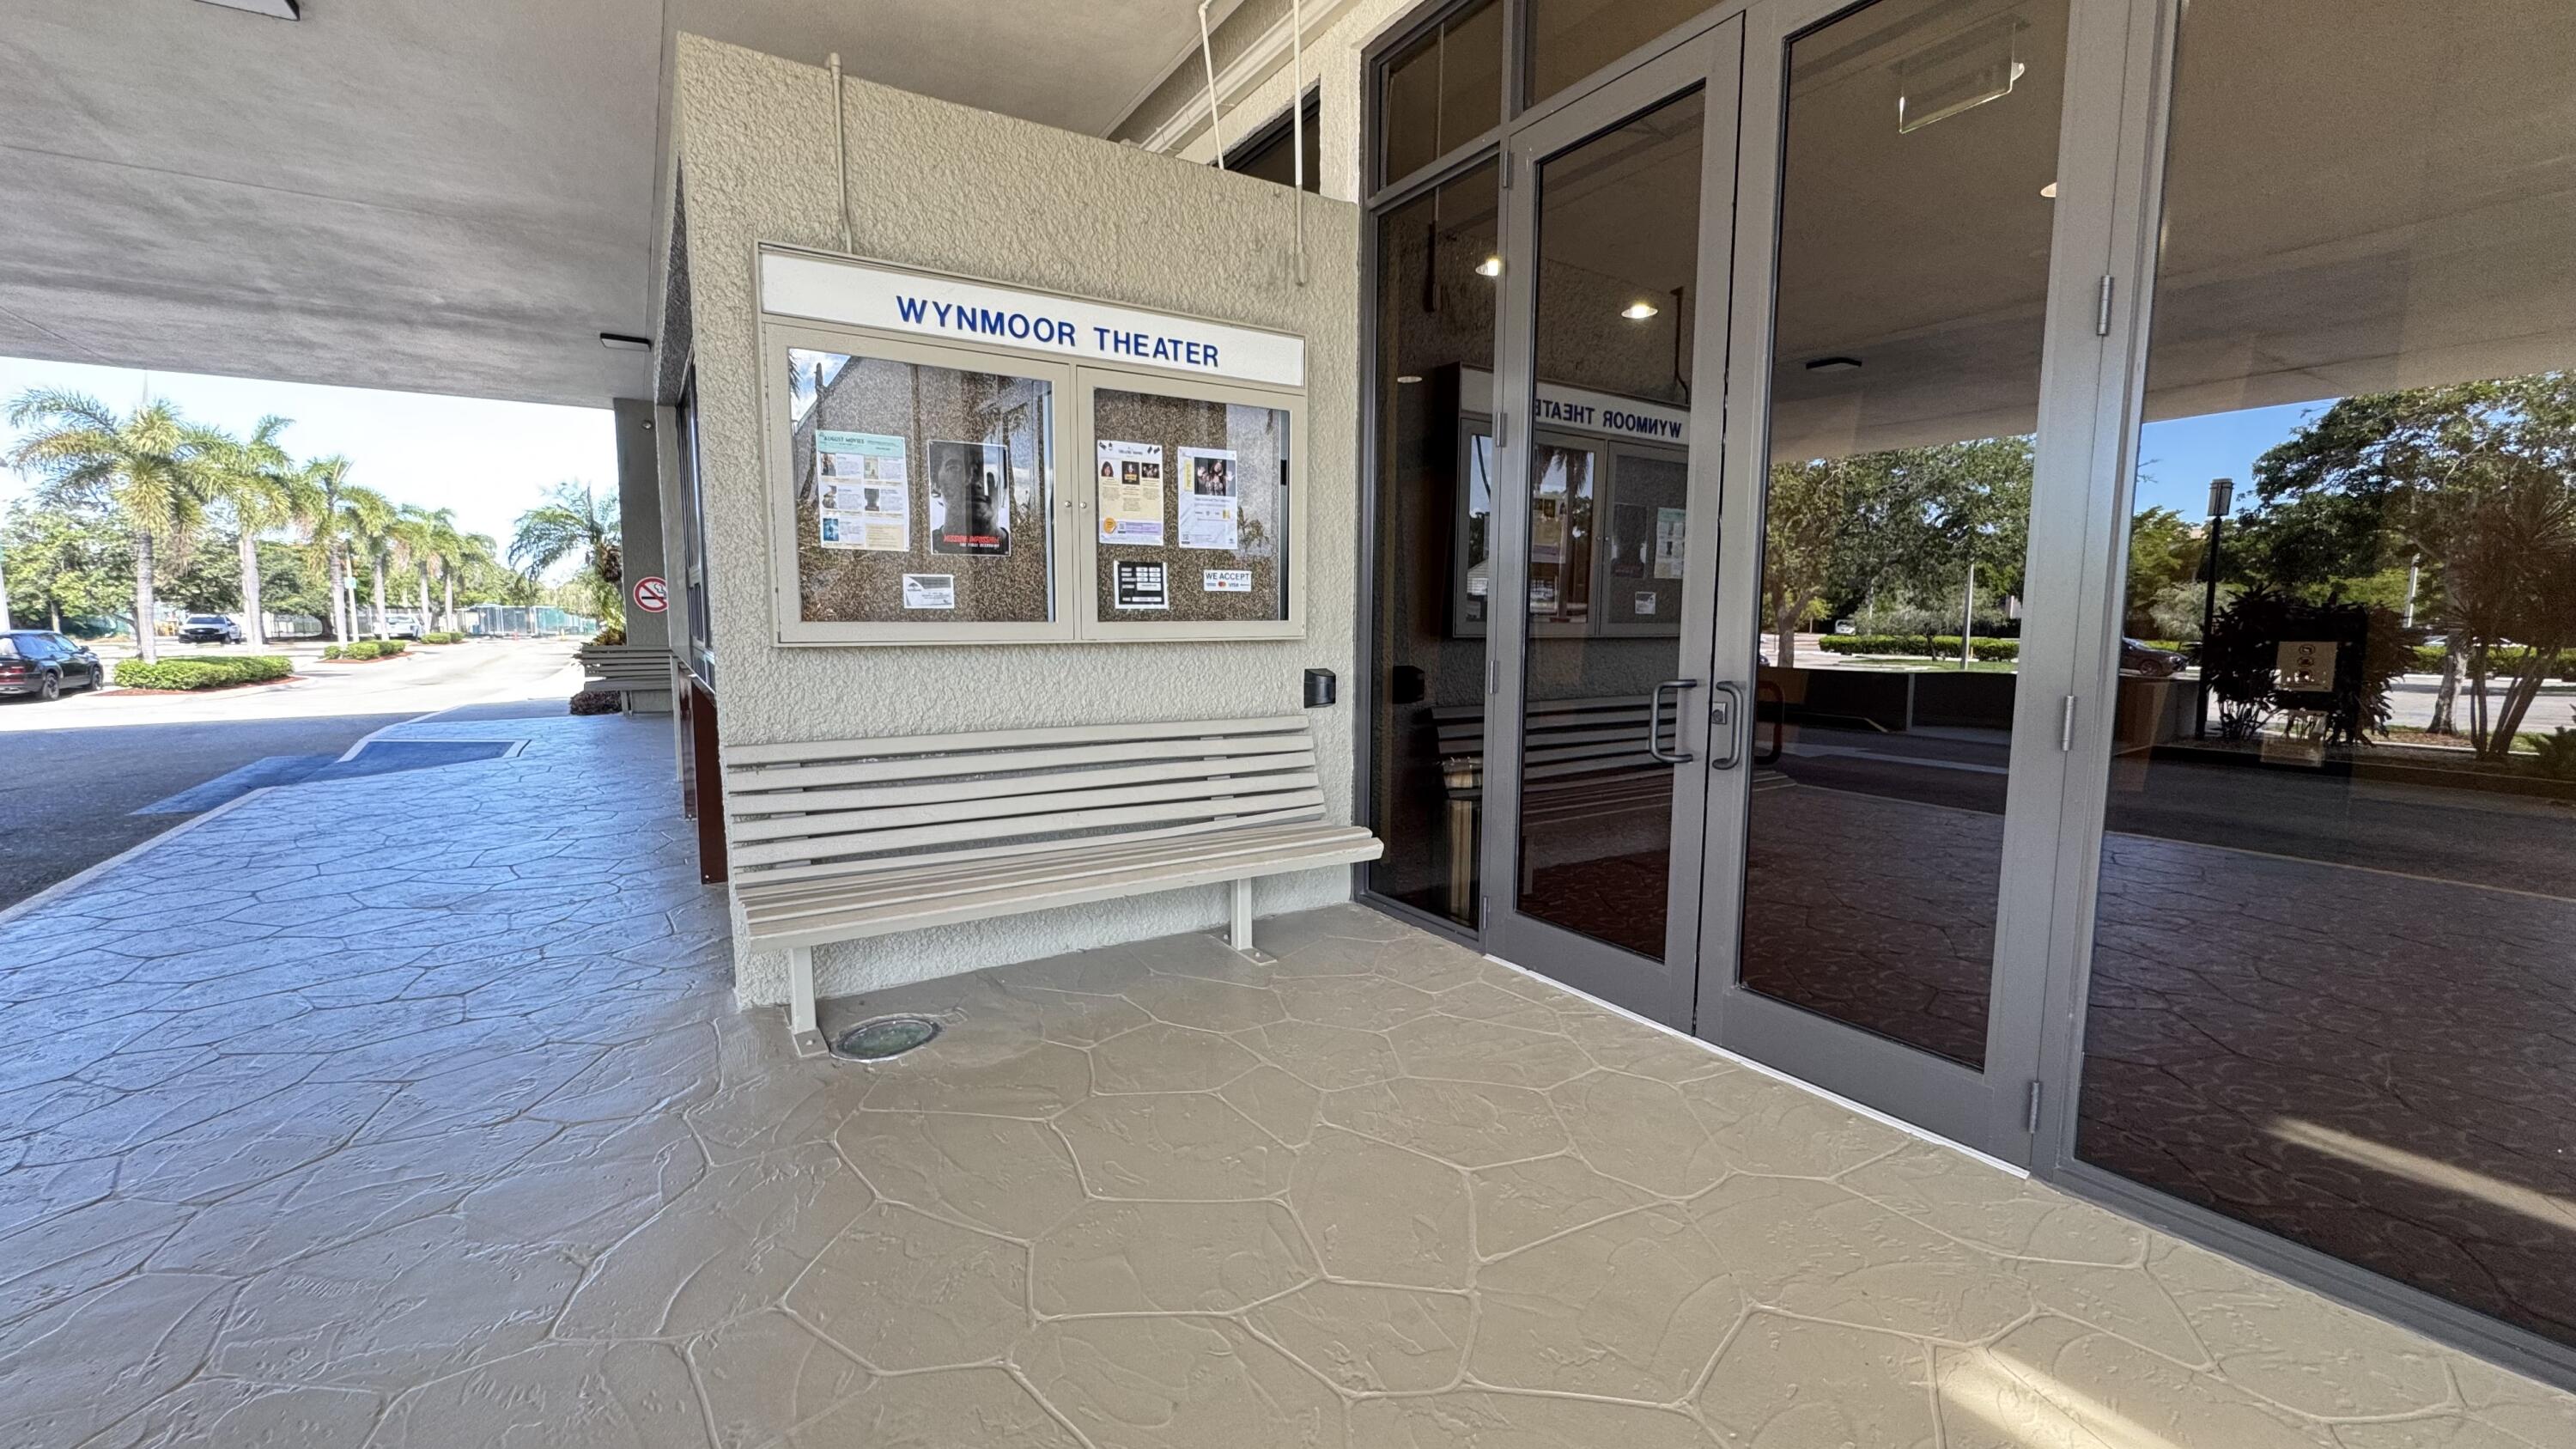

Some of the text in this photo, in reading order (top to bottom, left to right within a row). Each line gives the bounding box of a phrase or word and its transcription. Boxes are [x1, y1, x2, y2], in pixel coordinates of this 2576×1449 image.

[896, 295, 1219, 368] WYNMOOR THEATER
[1219, 572, 1250, 581] ACCEPT
